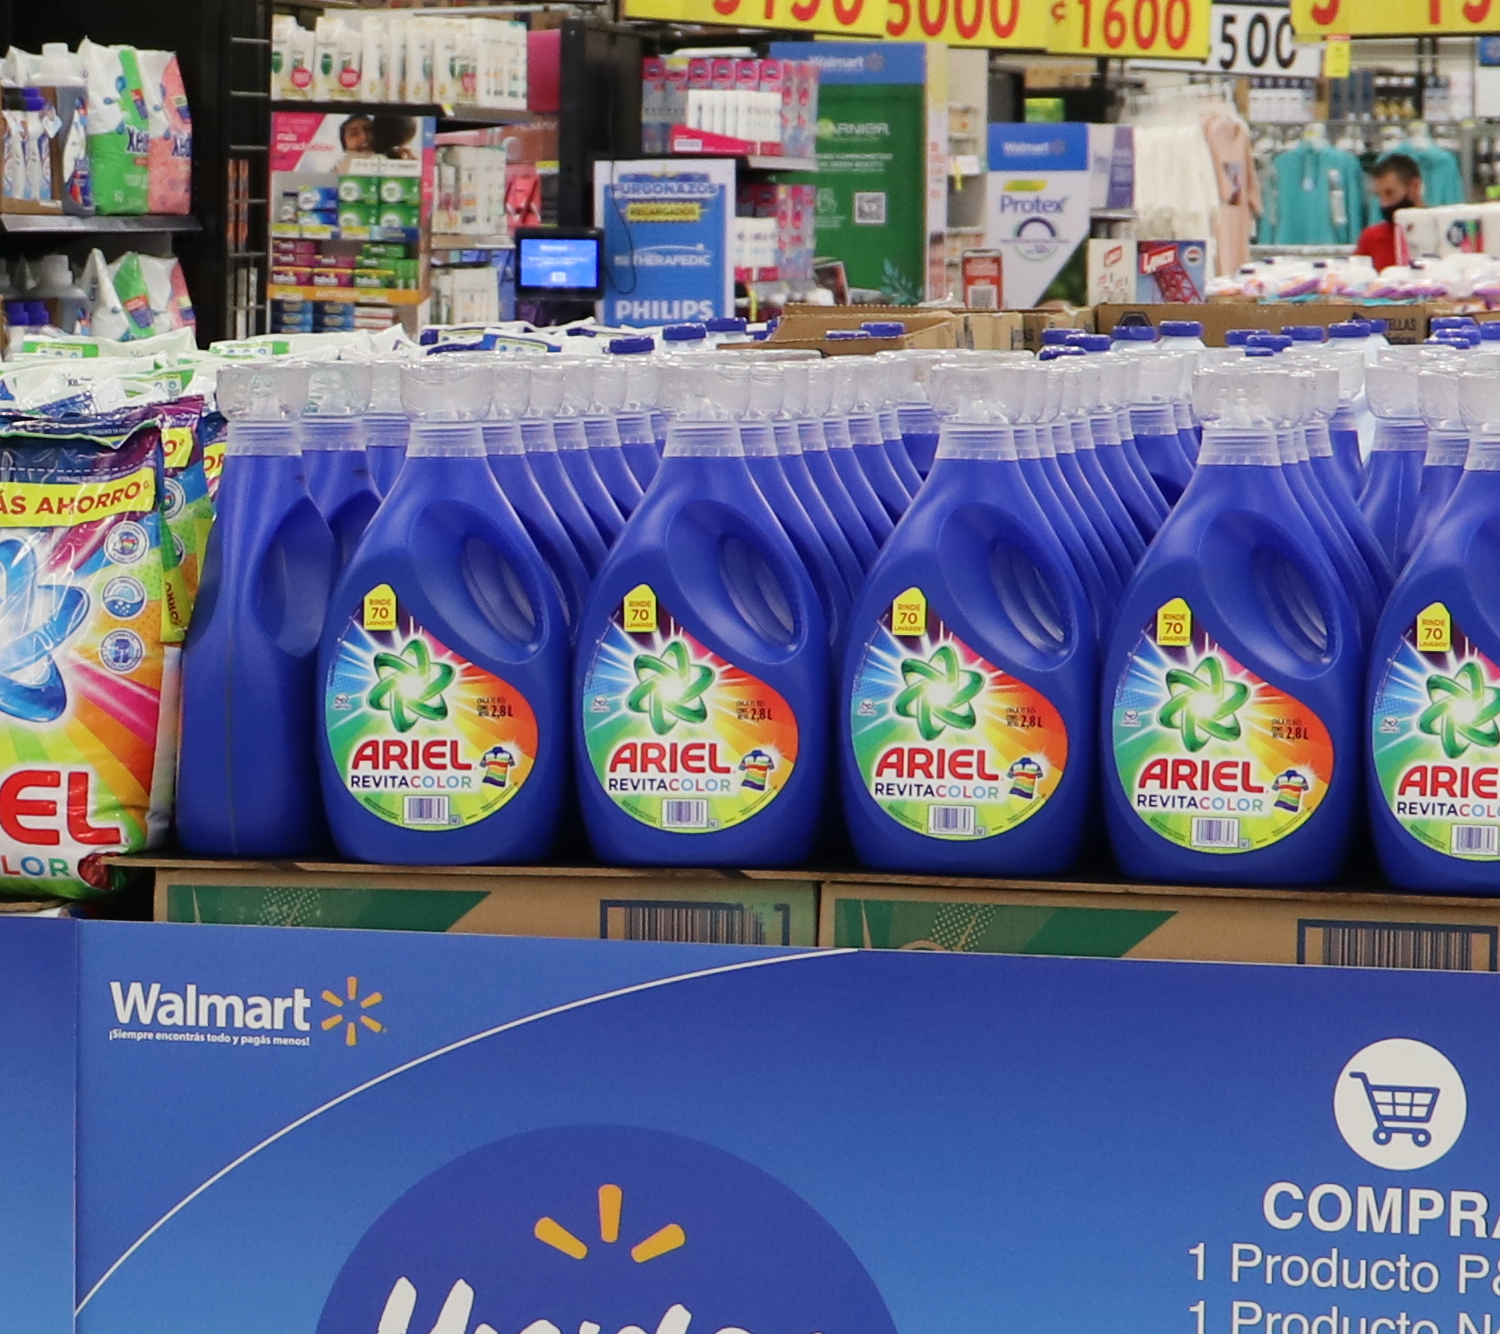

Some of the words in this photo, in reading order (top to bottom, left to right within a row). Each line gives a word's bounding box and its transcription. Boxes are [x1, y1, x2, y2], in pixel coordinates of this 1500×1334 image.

[1001, 195, 1067, 215] Protex
[615, 300, 715, 321] PHILIPS
[352, 740, 472, 771] ARIEL
[350, 774, 473, 791] REVITACOLOR
[109, 981, 311, 1032] Walmart
[109, 1028, 154, 1042] ¡Siempre
[156, 1030, 205, 1043] encontrás
[207, 1032, 231, 1044] todo
[232, 1036, 240, 1046] y
[241, 1033, 271, 1046] pagás
[273, 1035, 310, 1047] menos!
[1188, 1243, 1206, 1280] 1
[1230, 1244, 1439, 1294] Producto
